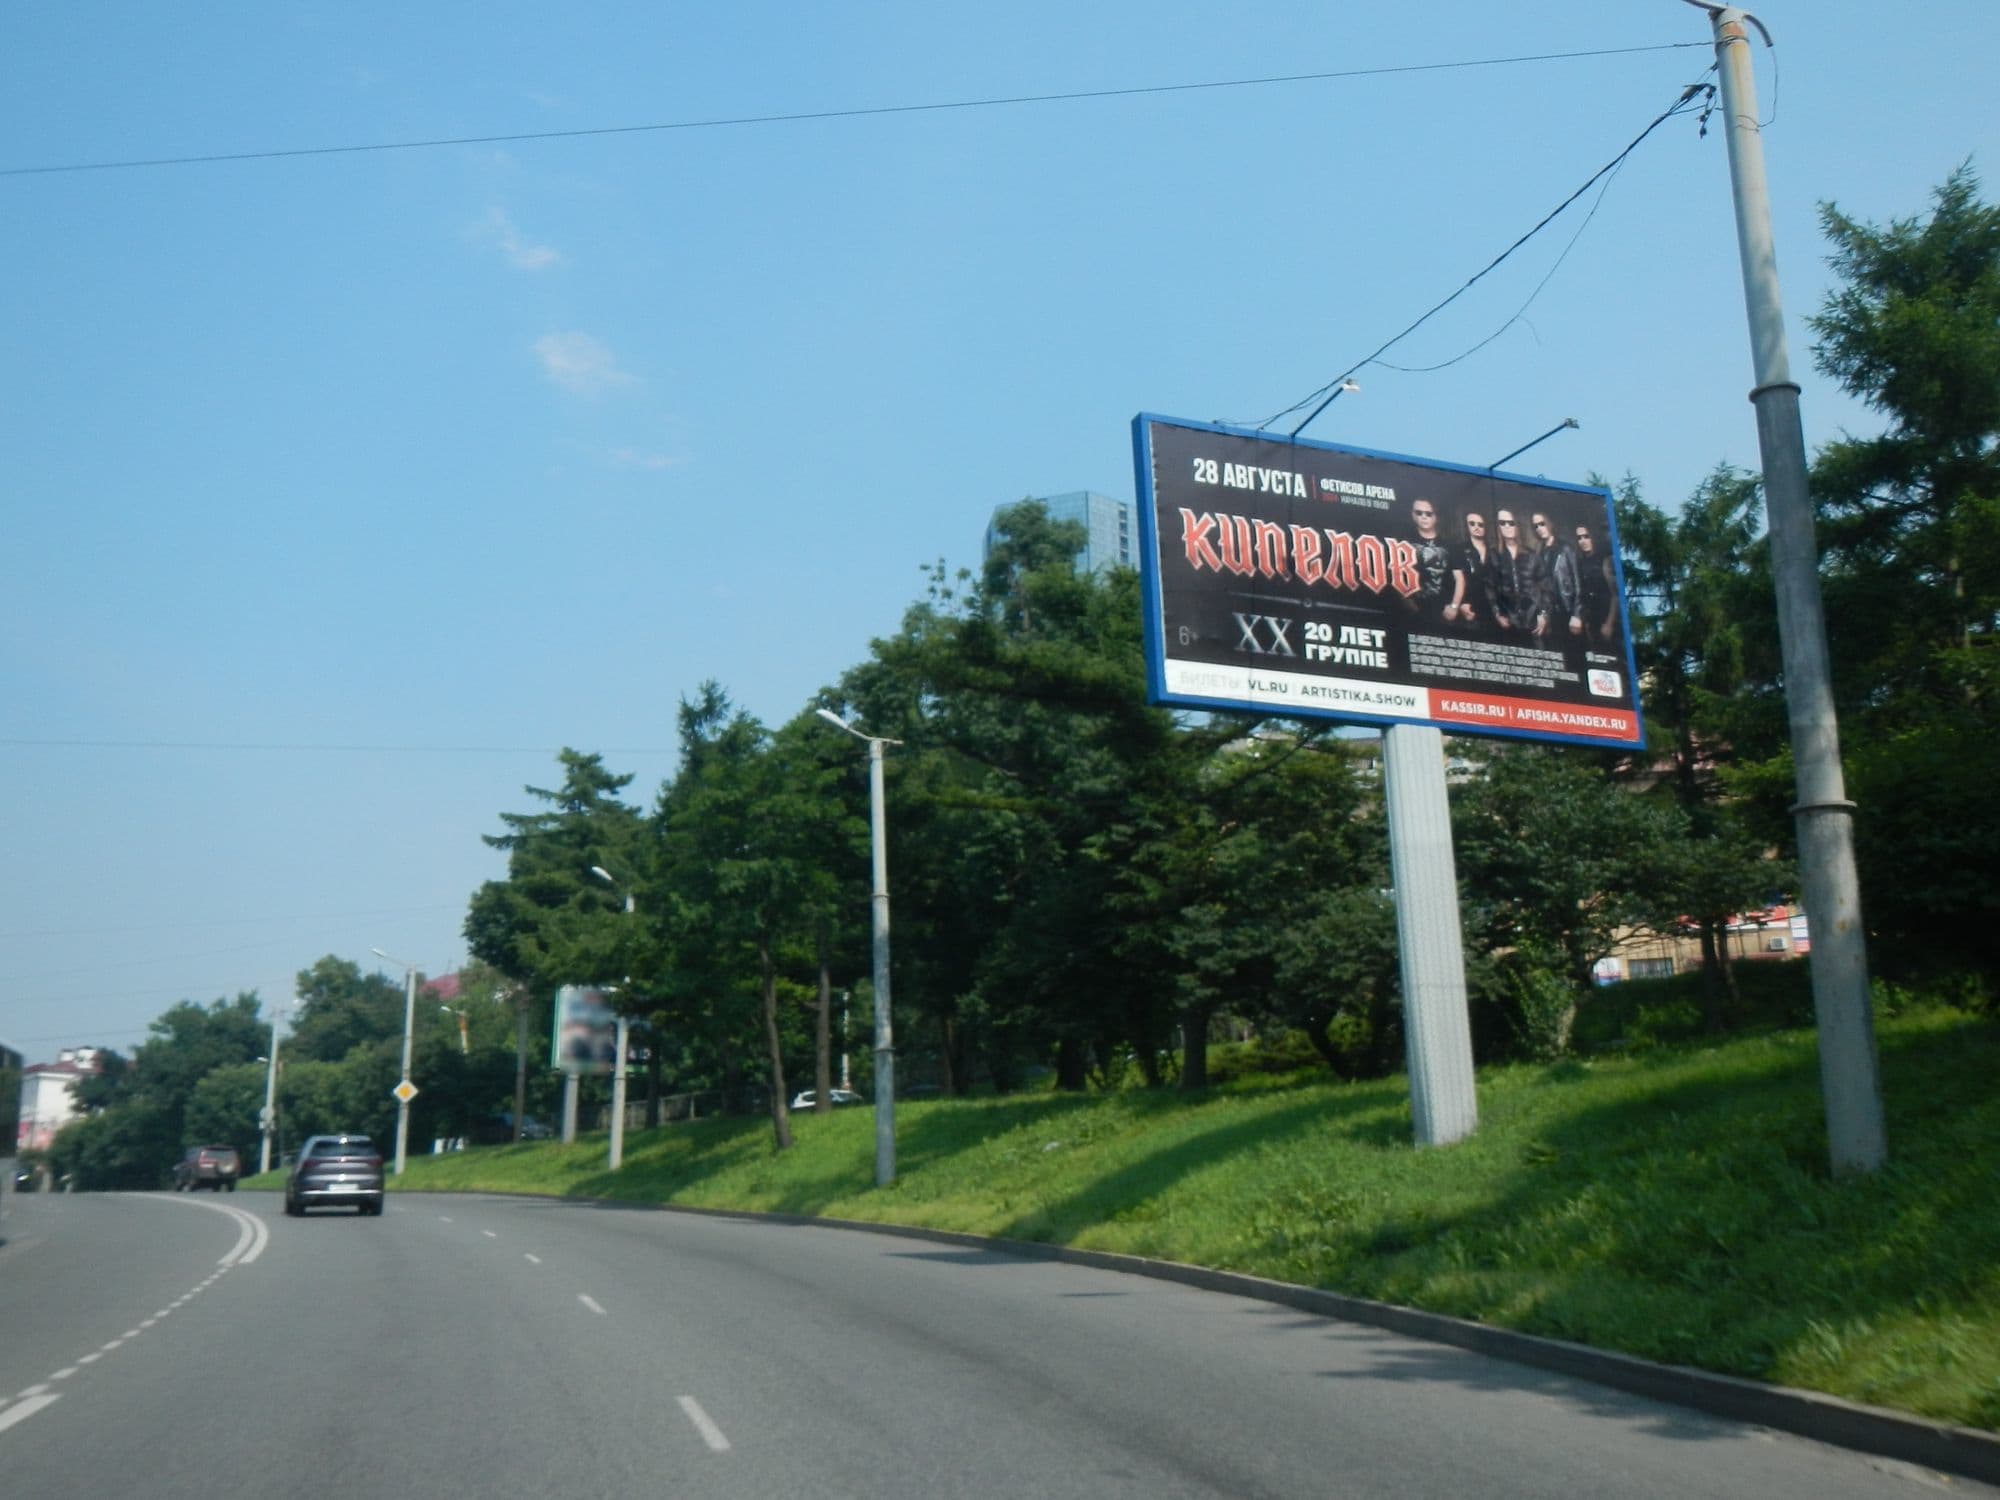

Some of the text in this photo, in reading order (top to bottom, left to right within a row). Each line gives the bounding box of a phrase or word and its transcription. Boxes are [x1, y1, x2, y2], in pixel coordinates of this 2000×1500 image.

[1193, 458, 1307, 498] 28 АВГУСТА
[1320, 478, 1396, 501] ФЕТИСОВ АРЕНА
[1232, 612, 1297, 657] XX
[1304, 622, 1386, 648] 20 ЛЕТ
[1305, 643, 1389, 668] ГРУППЕ
[1248, 679, 1416, 707] VL.RU ARTISTIKA.SHOW
[1441, 700, 1626, 730] KASSIR.RU AFISHA.YANDEX.RU
